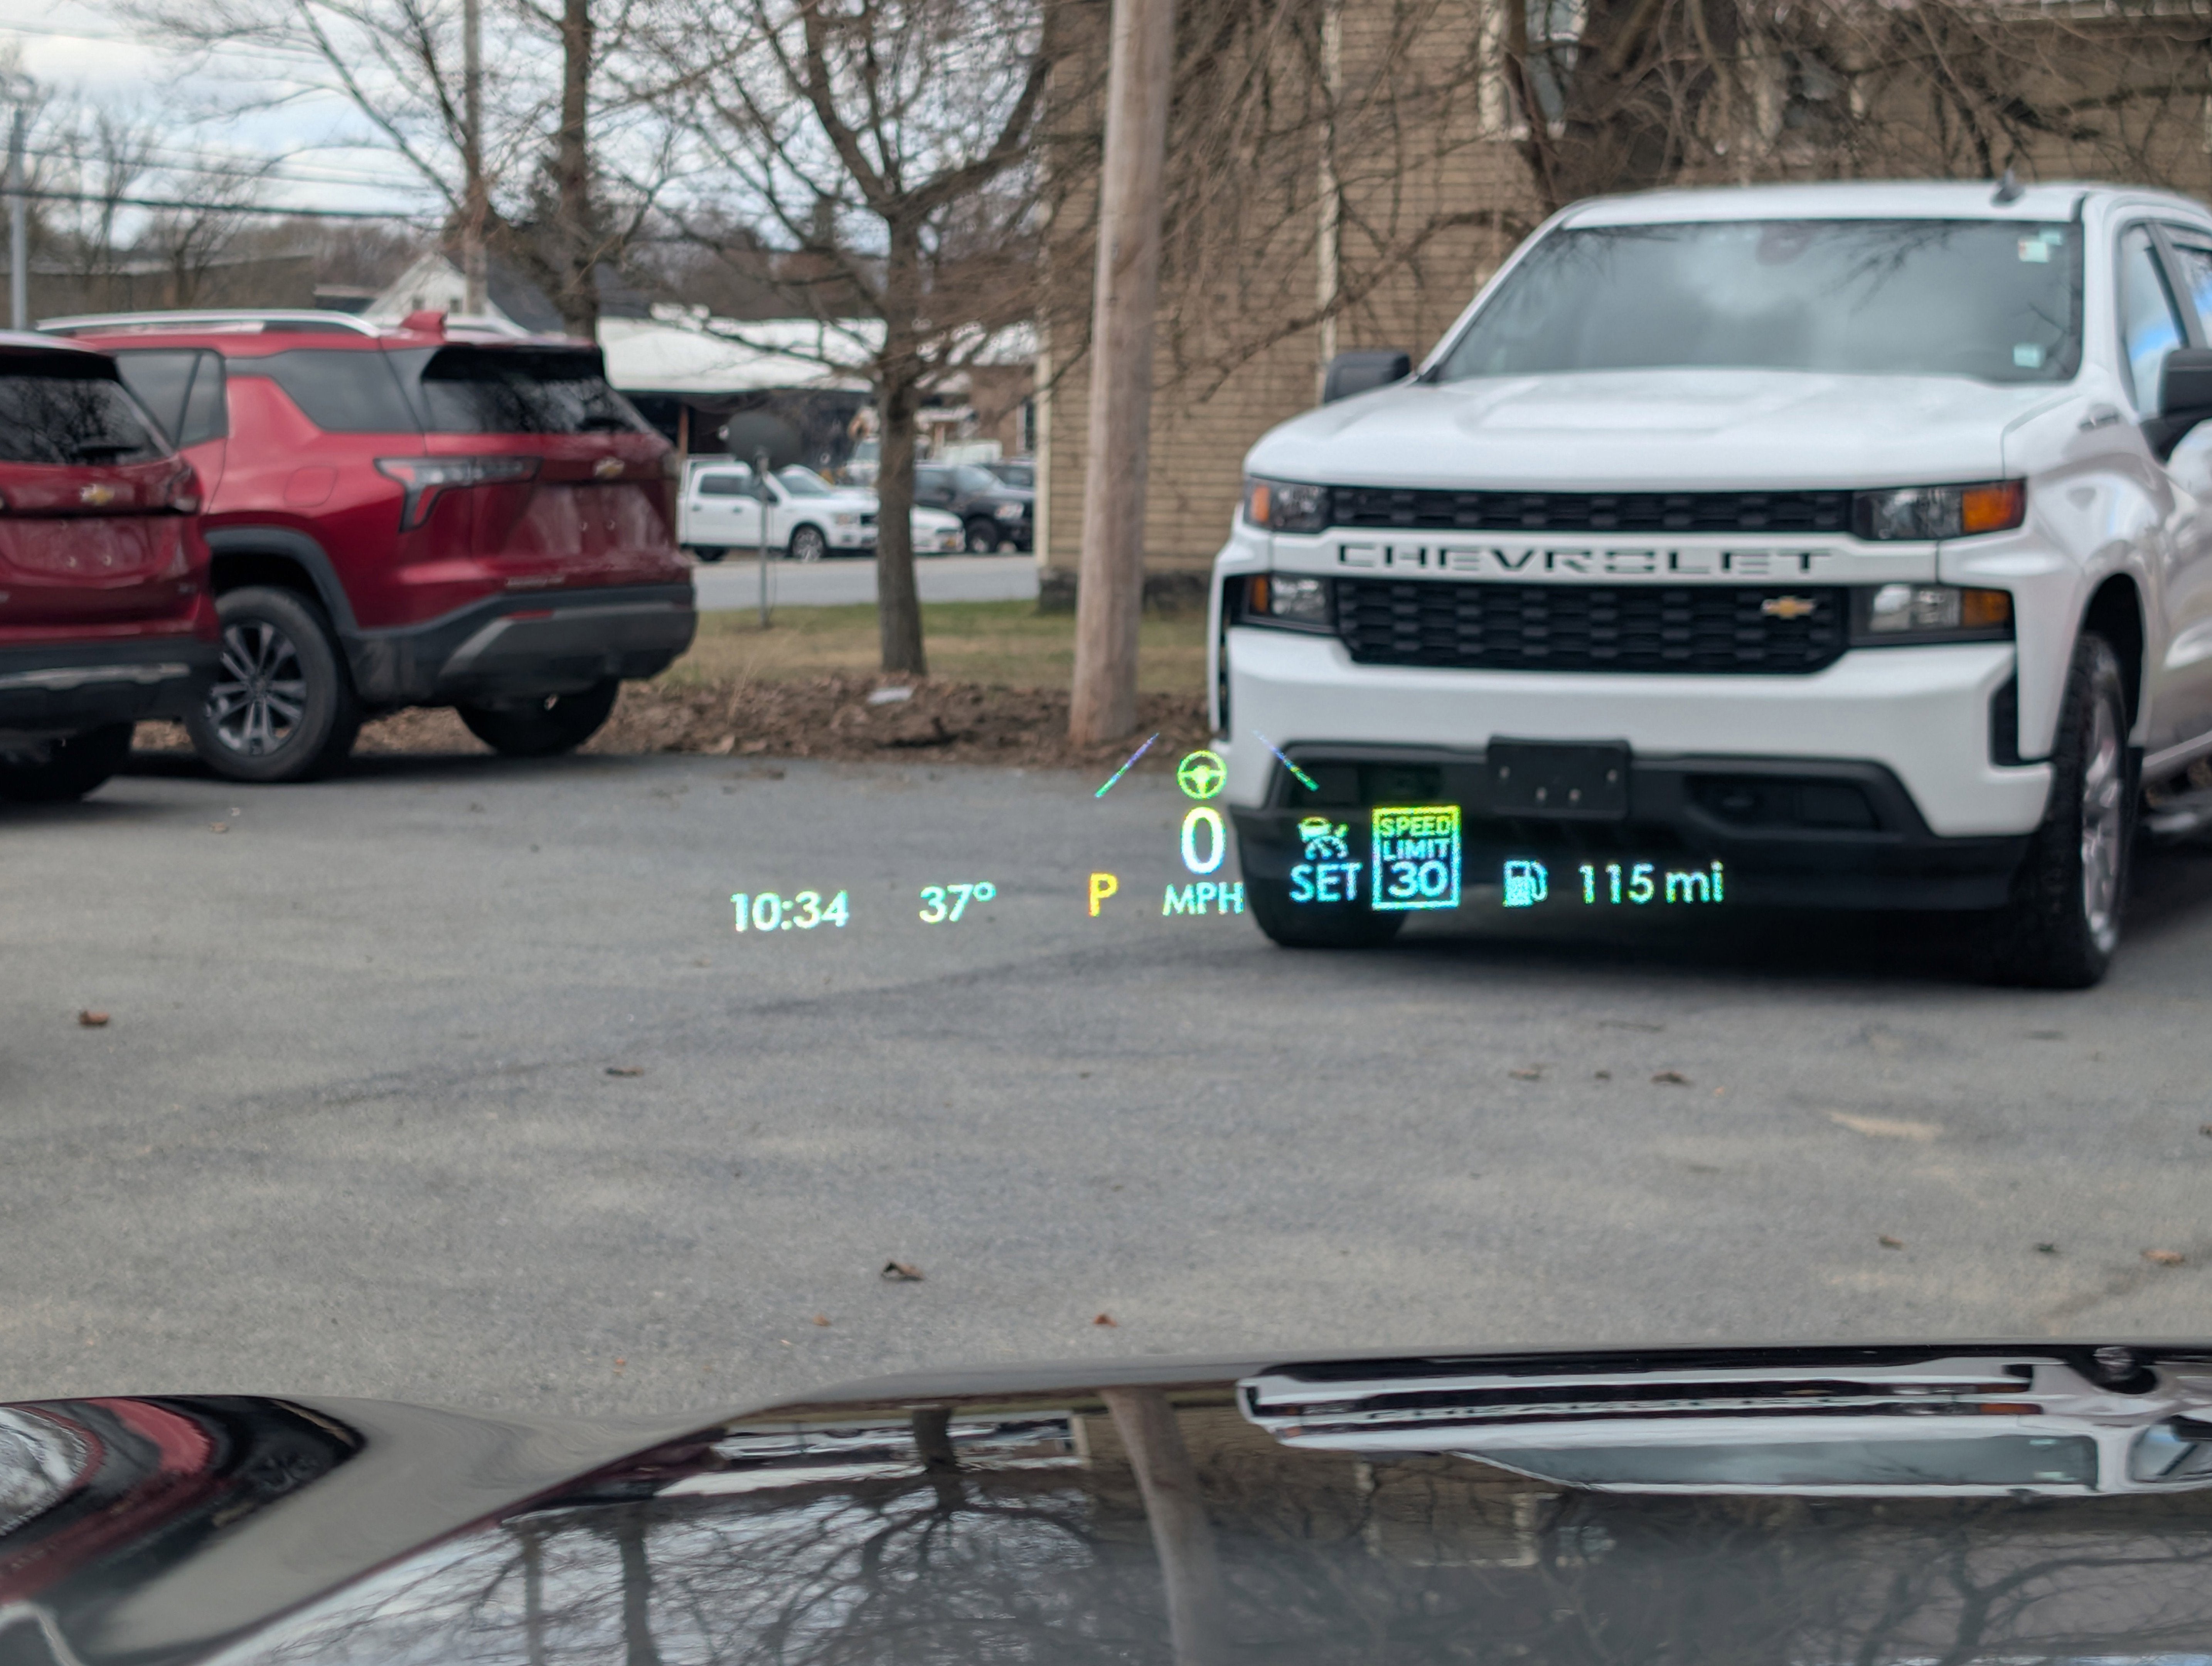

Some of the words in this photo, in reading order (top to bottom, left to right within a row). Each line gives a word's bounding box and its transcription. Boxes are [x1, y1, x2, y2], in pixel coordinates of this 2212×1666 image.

[1338, 543, 1831, 574] CHEVROLET
[1181, 806, 1225, 875] 0
[1380, 816, 1452, 838] SPEED
[1383, 838, 1451, 861] LIMIT
[1088, 872, 1118, 917] P
[1162, 881, 1244, 916] MPH
[1289, 862, 1363, 903] SET
[1388, 860, 1449, 898] 30
[1579, 862, 1655, 905] 115
[1664, 860, 1724, 904] mi
[730, 890, 849, 932] 10:34
[919, 881, 996, 922] 37°
